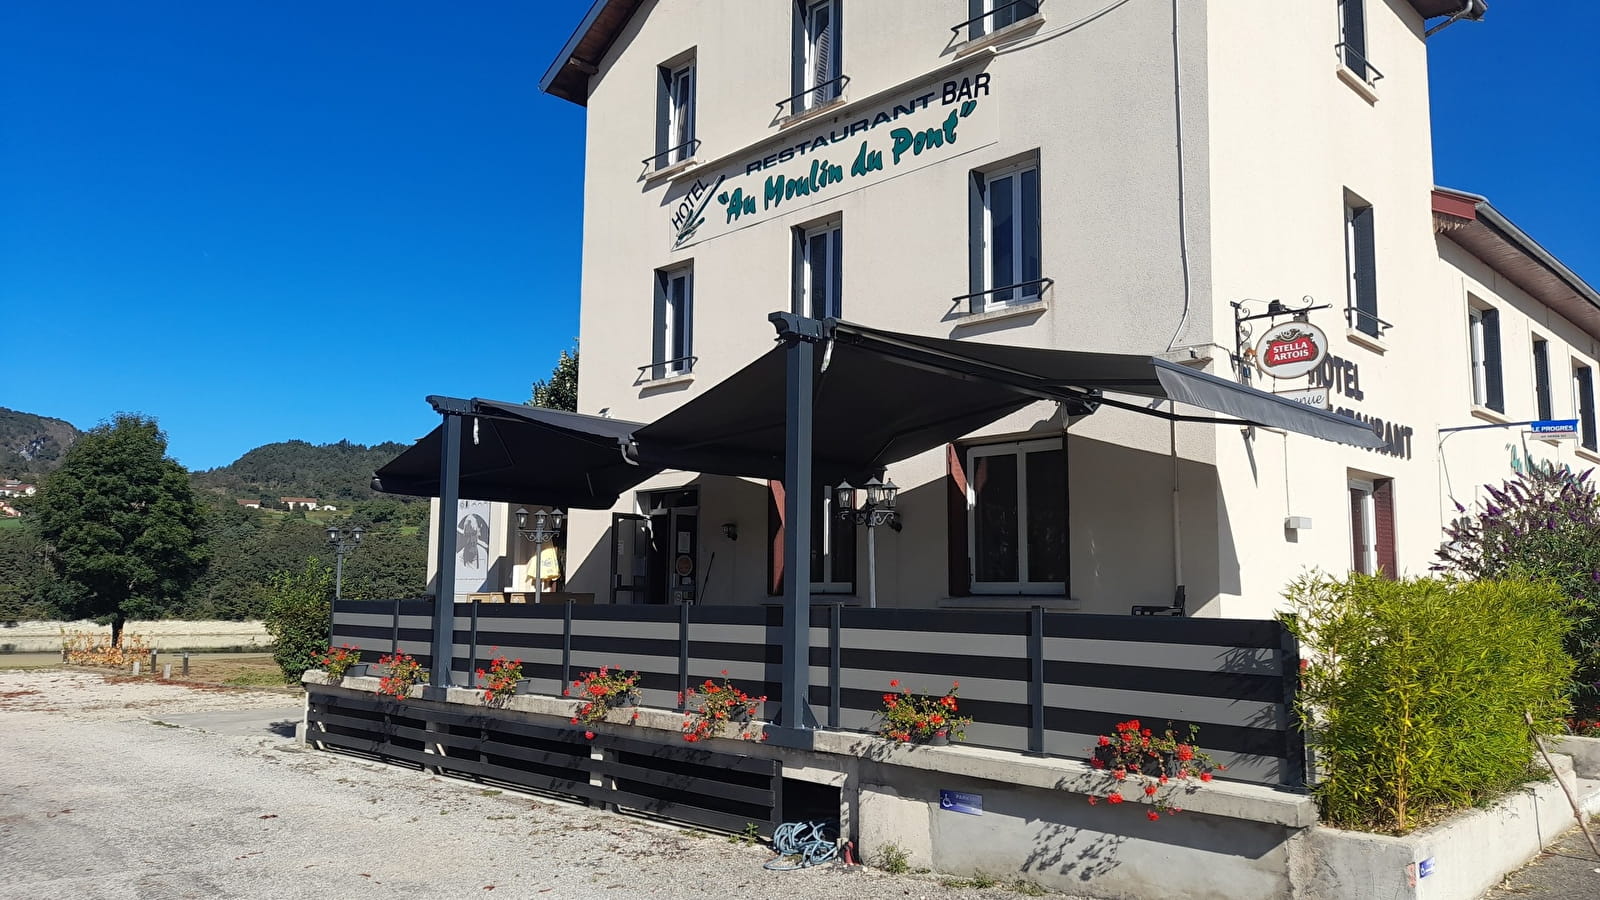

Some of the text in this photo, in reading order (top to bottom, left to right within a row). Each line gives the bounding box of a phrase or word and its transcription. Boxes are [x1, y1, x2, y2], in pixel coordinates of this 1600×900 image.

[746, 72, 990, 175] RESTAURANT BAR
[764, 160, 843, 210] Moulin
[851, 141, 882, 177] du
[671, 180, 709, 230] HOTEL
[1273, 341, 1308, 354] STELLA
[1273, 349, 1309, 361] ARTOIS
